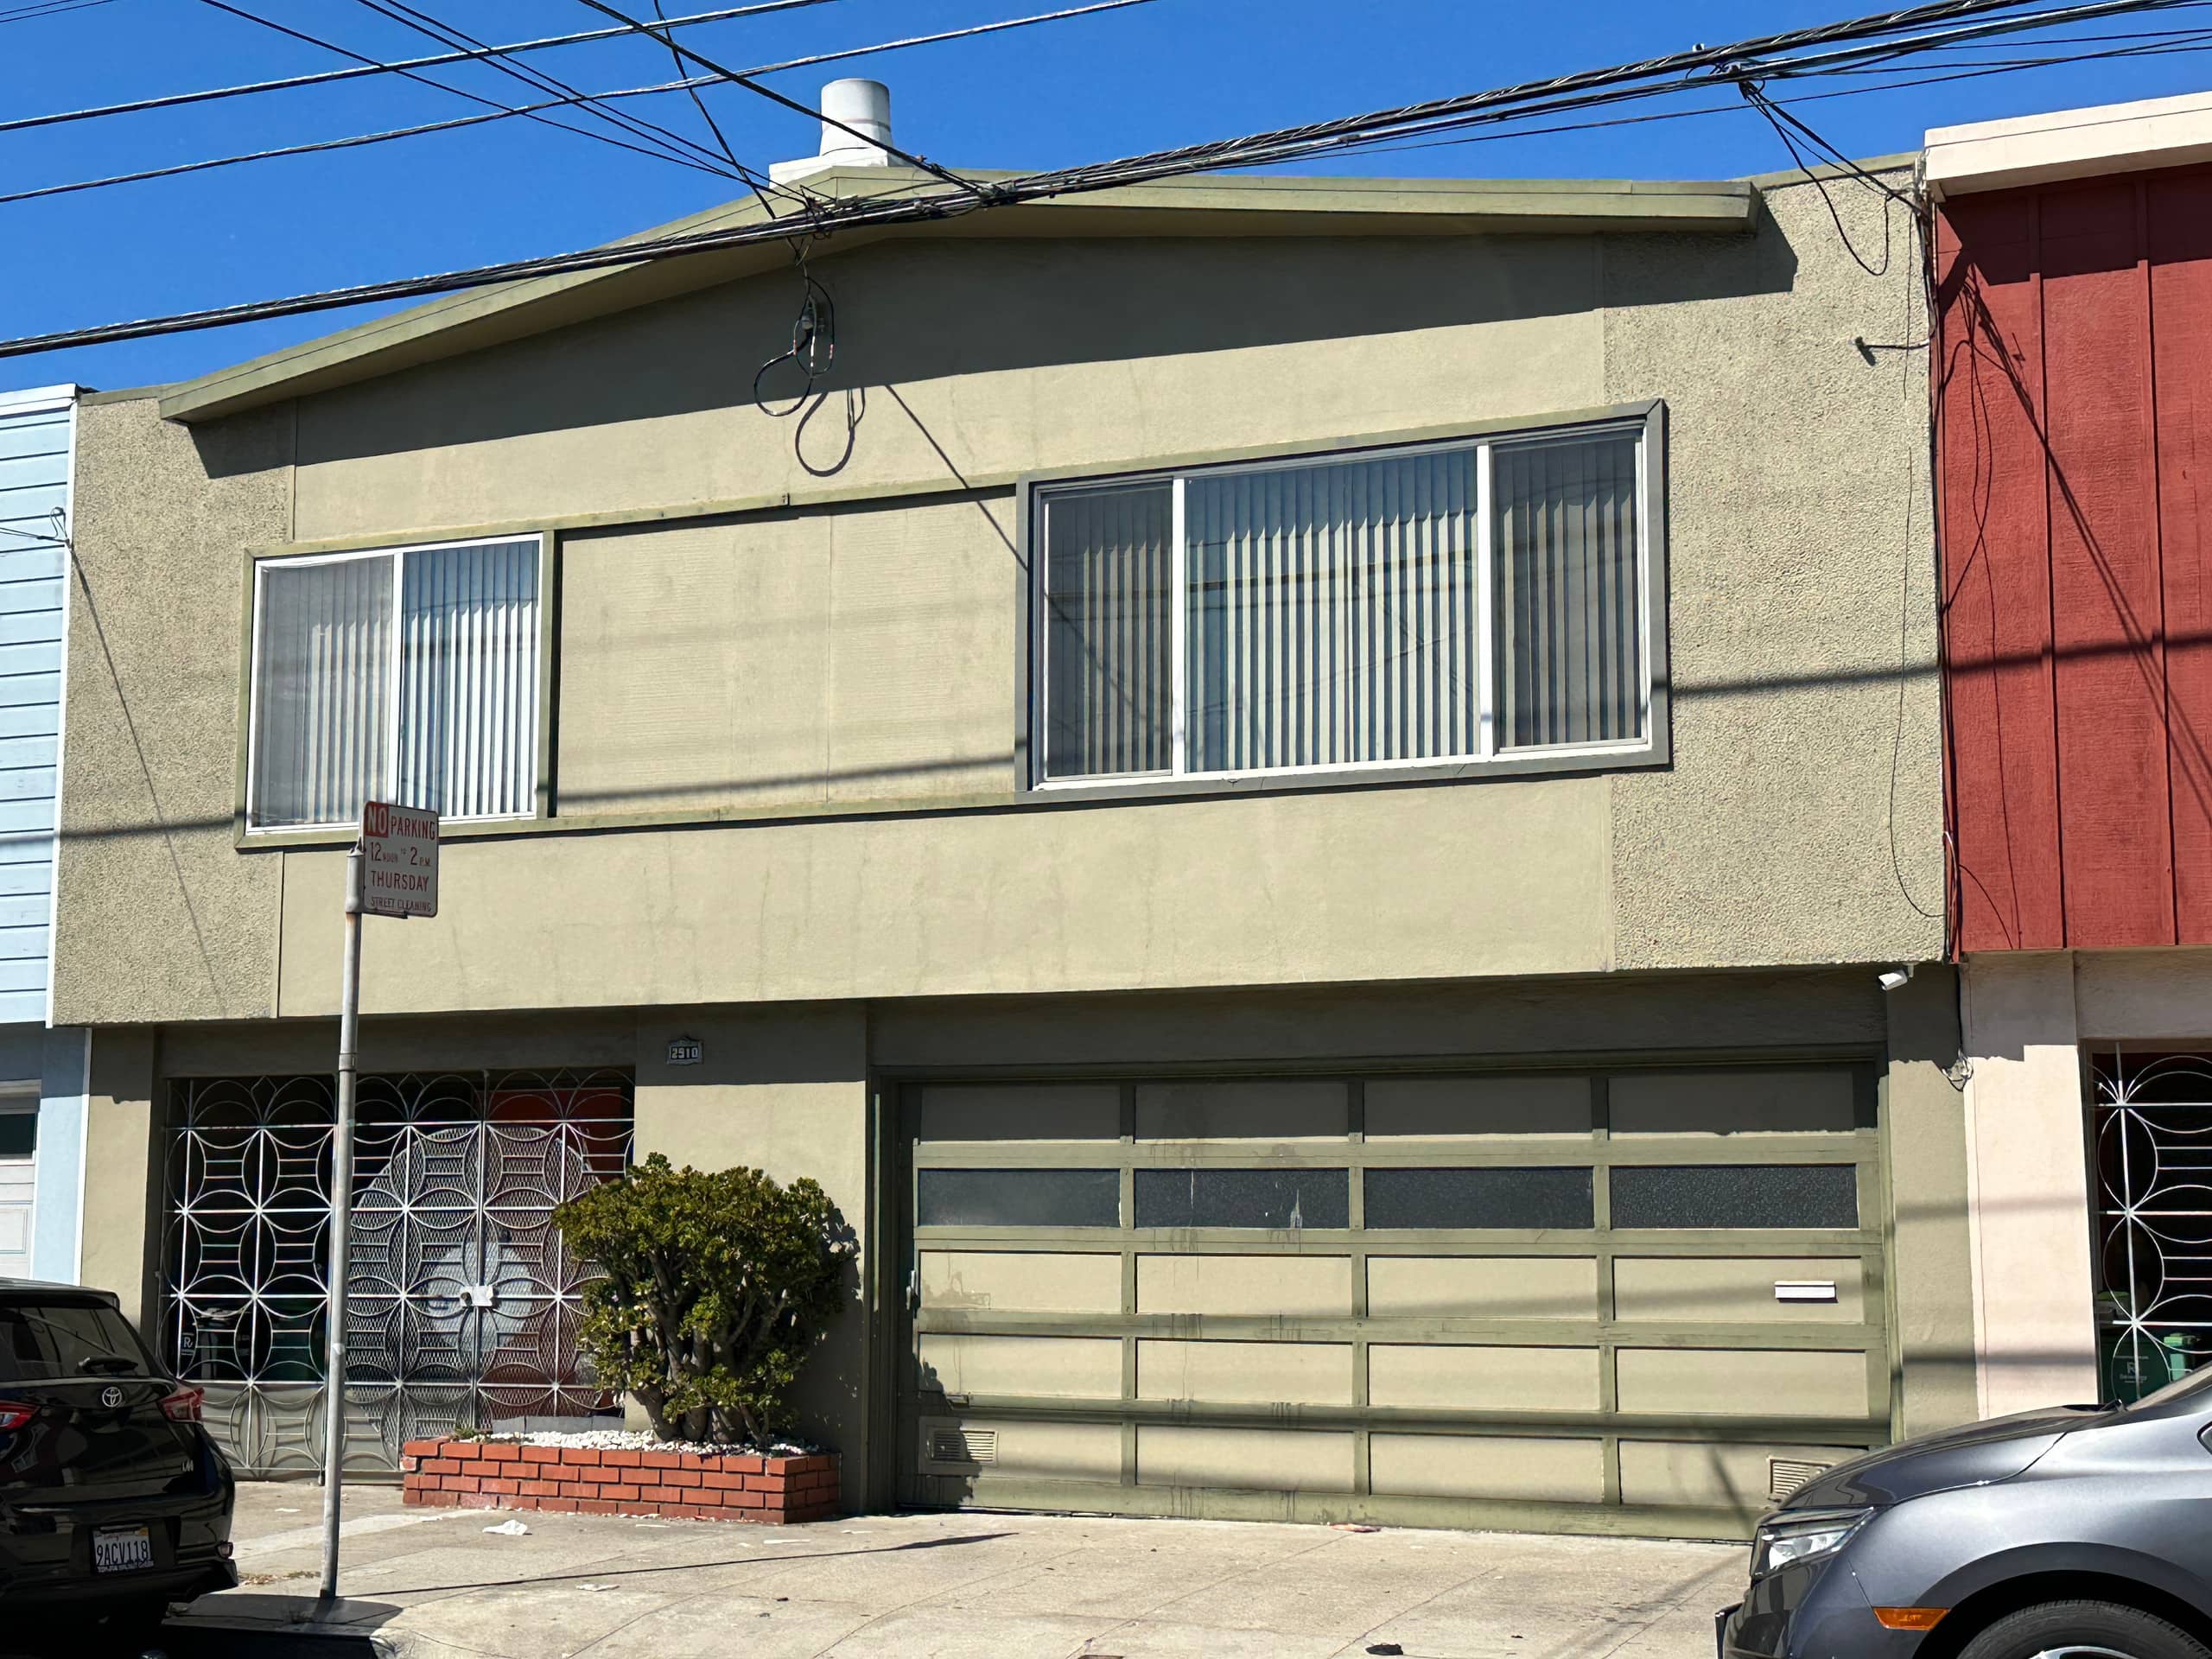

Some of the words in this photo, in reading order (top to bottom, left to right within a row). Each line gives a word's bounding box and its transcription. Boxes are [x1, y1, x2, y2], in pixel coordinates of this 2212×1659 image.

[367, 805, 387, 835] NO
[391, 815, 435, 841] PARKING
[371, 842, 382, 862] 12
[410, 846, 418, 866] 2
[419, 856, 431, 868] PM
[371, 870, 429, 893] THURSDAY
[372, 896, 395, 909] STREET
[397, 899, 431, 912] CLEANING
[671, 1047, 698, 1058] 2910
[97, 1541, 149, 1566] 9ACV118
